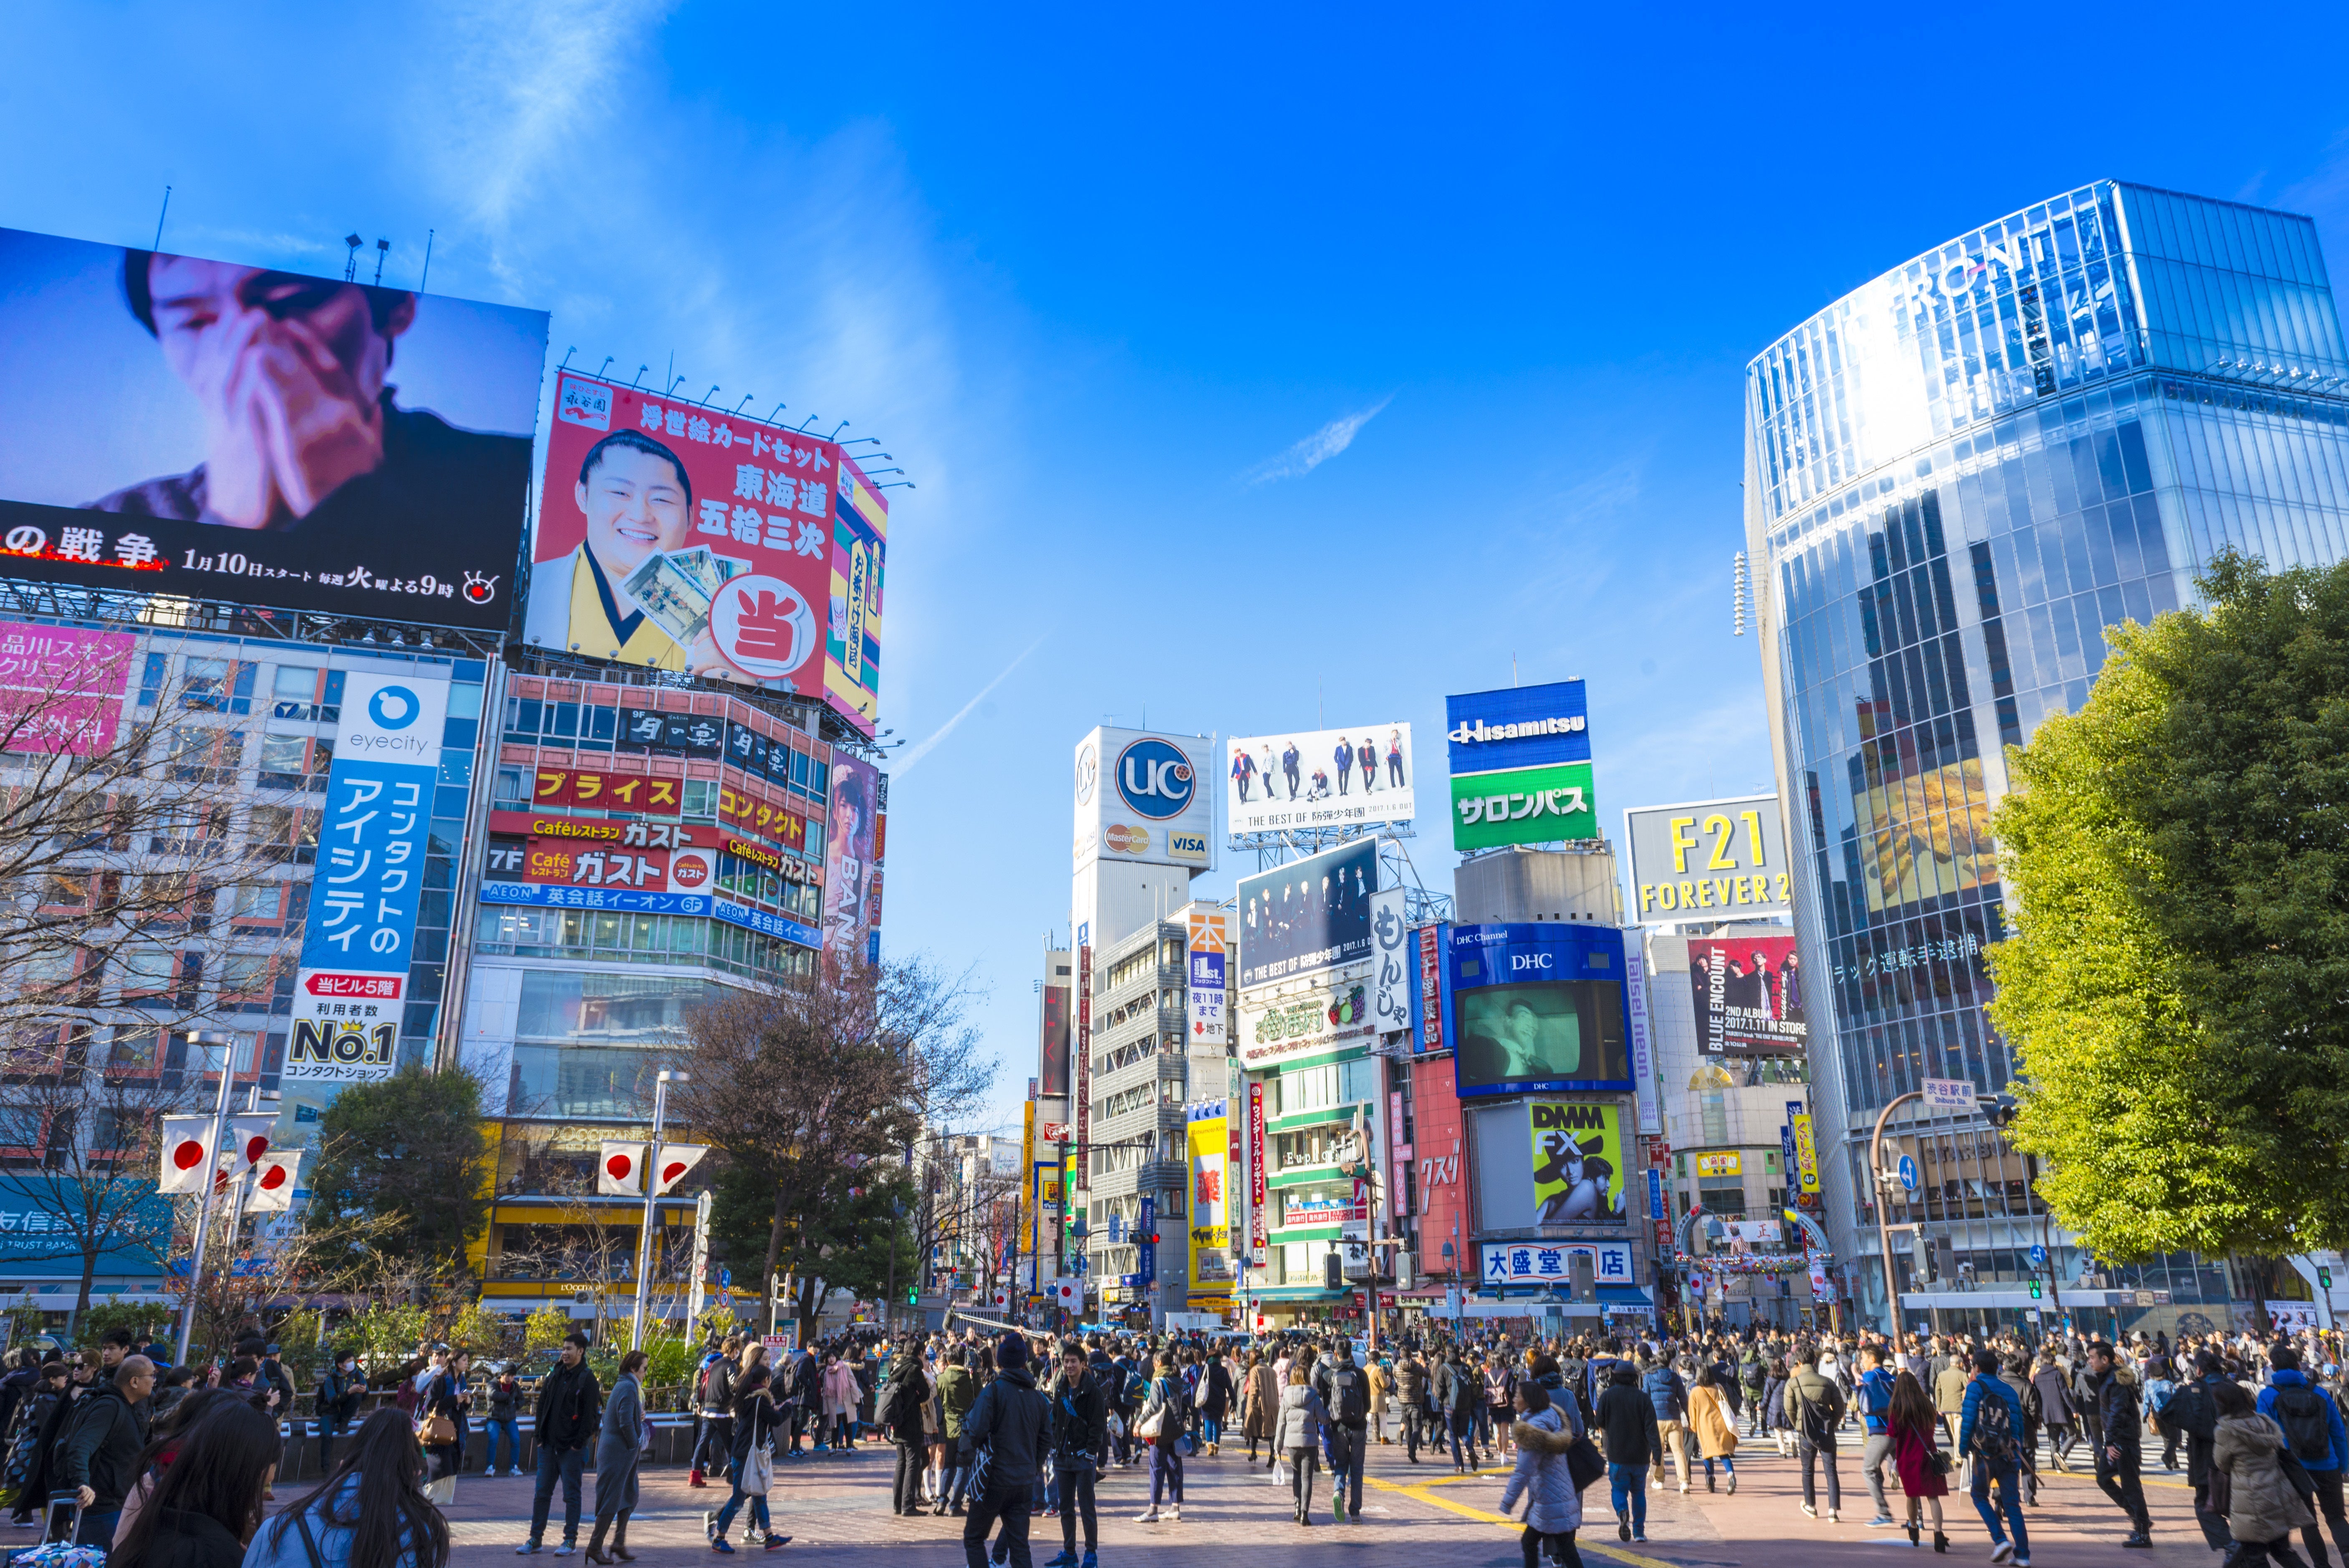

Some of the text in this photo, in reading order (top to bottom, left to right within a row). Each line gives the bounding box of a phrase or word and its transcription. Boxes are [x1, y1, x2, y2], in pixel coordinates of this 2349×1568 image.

[565, 391, 606, 412] 永谷園
[570, 383, 606, 397] 味ひとすじ
[640, 403, 831, 473] 浮世絵カードセット
[735, 464, 828, 519] 東海道
[697, 499, 825, 560] 五拾三次
[5, 525, 158, 566] の戦争
[182, 548, 454, 598] 1月10日スタート 毎週火曜よる9時
[848, 552, 865, 669] お茶づけ海苔
[734, 589, 798, 663] 当
[2, 634, 121, 662] 品川スキン
[0, 657, 104, 683] クリニック
[633, 710, 646, 718] 9F
[631, 717, 715, 746] 月の宴
[1448, 716, 1585, 744] Hisamitsu
[351, 733, 428, 756] eyecity
[733, 733, 784, 772] 月の宴
[538, 772, 676, 806] プライス
[719, 789, 802, 839] コンタクト
[1248, 816, 1265, 827] THE
[1269, 814, 1292, 825] BEST
[1296, 812, 1307, 823] OF
[1369, 804, 1396, 813] 2017.1.6
[1458, 787, 1587, 825] サロンパス
[533, 820, 692, 849] Caféレストラン ガスト
[1106, 831, 1150, 845] MasterCard
[1173, 837, 1205, 852] VISA
[1670, 810, 1764, 873] F21
[323, 777, 383, 952] アイシティ
[370, 782, 420, 954] コンタクトの
[489, 849, 525, 870] 7F
[531, 852, 570, 867] Café
[531, 867, 568, 878] レストラン
[573, 852, 660, 886] ガスト
[729, 839, 817, 885] Caféレストラン ガスト
[677, 869, 705, 879] ガスト
[488, 886, 701, 910] AEON 英会話イーオン 6F
[872, 895, 880, 919] ガスト
[1640, 875, 1769, 913] FOREVER
[719, 902, 821, 943] AEON 英会話イーオン
[1190, 915, 1225, 953] 本
[1456, 930, 1508, 945] DHC Channel
[1254, 965, 1267, 981] THE
[1269, 960, 1287, 977] BEST
[1289, 956, 1298, 972] OF
[1343, 939, 1365, 952] 2017.1.6
[1374, 904, 1407, 1026] もんじゃ
[1511, 953, 1553, 970] DHC
[317, 976, 393, 996] 当ビル5階
[1192, 992, 1223, 1005] 夜11時
[1419, 930, 1438, 1043] 三千里薬品
[1709, 946, 1726, 1052] BLUE ENCOUNT
[316, 1002, 378, 1017] 利用者数
[1198, 1006, 1217, 1017] まで
[1627, 951, 1649, 1078] Taisei neon
[1725, 1006, 1770, 1019] 2ND ALBUM
[1206, 1023, 1224, 1035] 地下
[1284, 1009, 1323, 1038] 西村
[1725, 1016, 1766, 1031] 2017.1.11
[1768, 1019, 1777, 1033] IN
[290, 1018, 397, 1065] No.1
[285, 1065, 391, 1079] コンタクトショップ
[1230, 1078, 1238, 1092] 西村
[1927, 1082, 1973, 1098] 渋谷駅前
[1934, 1096, 1955, 1105] Shibuya
[1532, 1105, 1606, 1130] DMM
[548, 1126, 646, 1142] L'OCCITANE
[1190, 1127, 1216, 1136] Matsumoto
[1534, 1131, 1583, 1156] FX
[1252, 1105, 1262, 1196] ウィンターフルーツギフト
[1711, 1156, 1727, 1165] 麻雀
[1197, 1170, 1221, 1205] 薬
[1422, 1138, 1461, 1215] クスリ
[1804, 1175, 1815, 1184] 4F
[1287, 1213, 1327, 1223] 国内旅行 海外旅行
[8, 1240, 77, 1250] TRUST BANK
[1489, 1249, 1623, 1276] 大盛堂店
